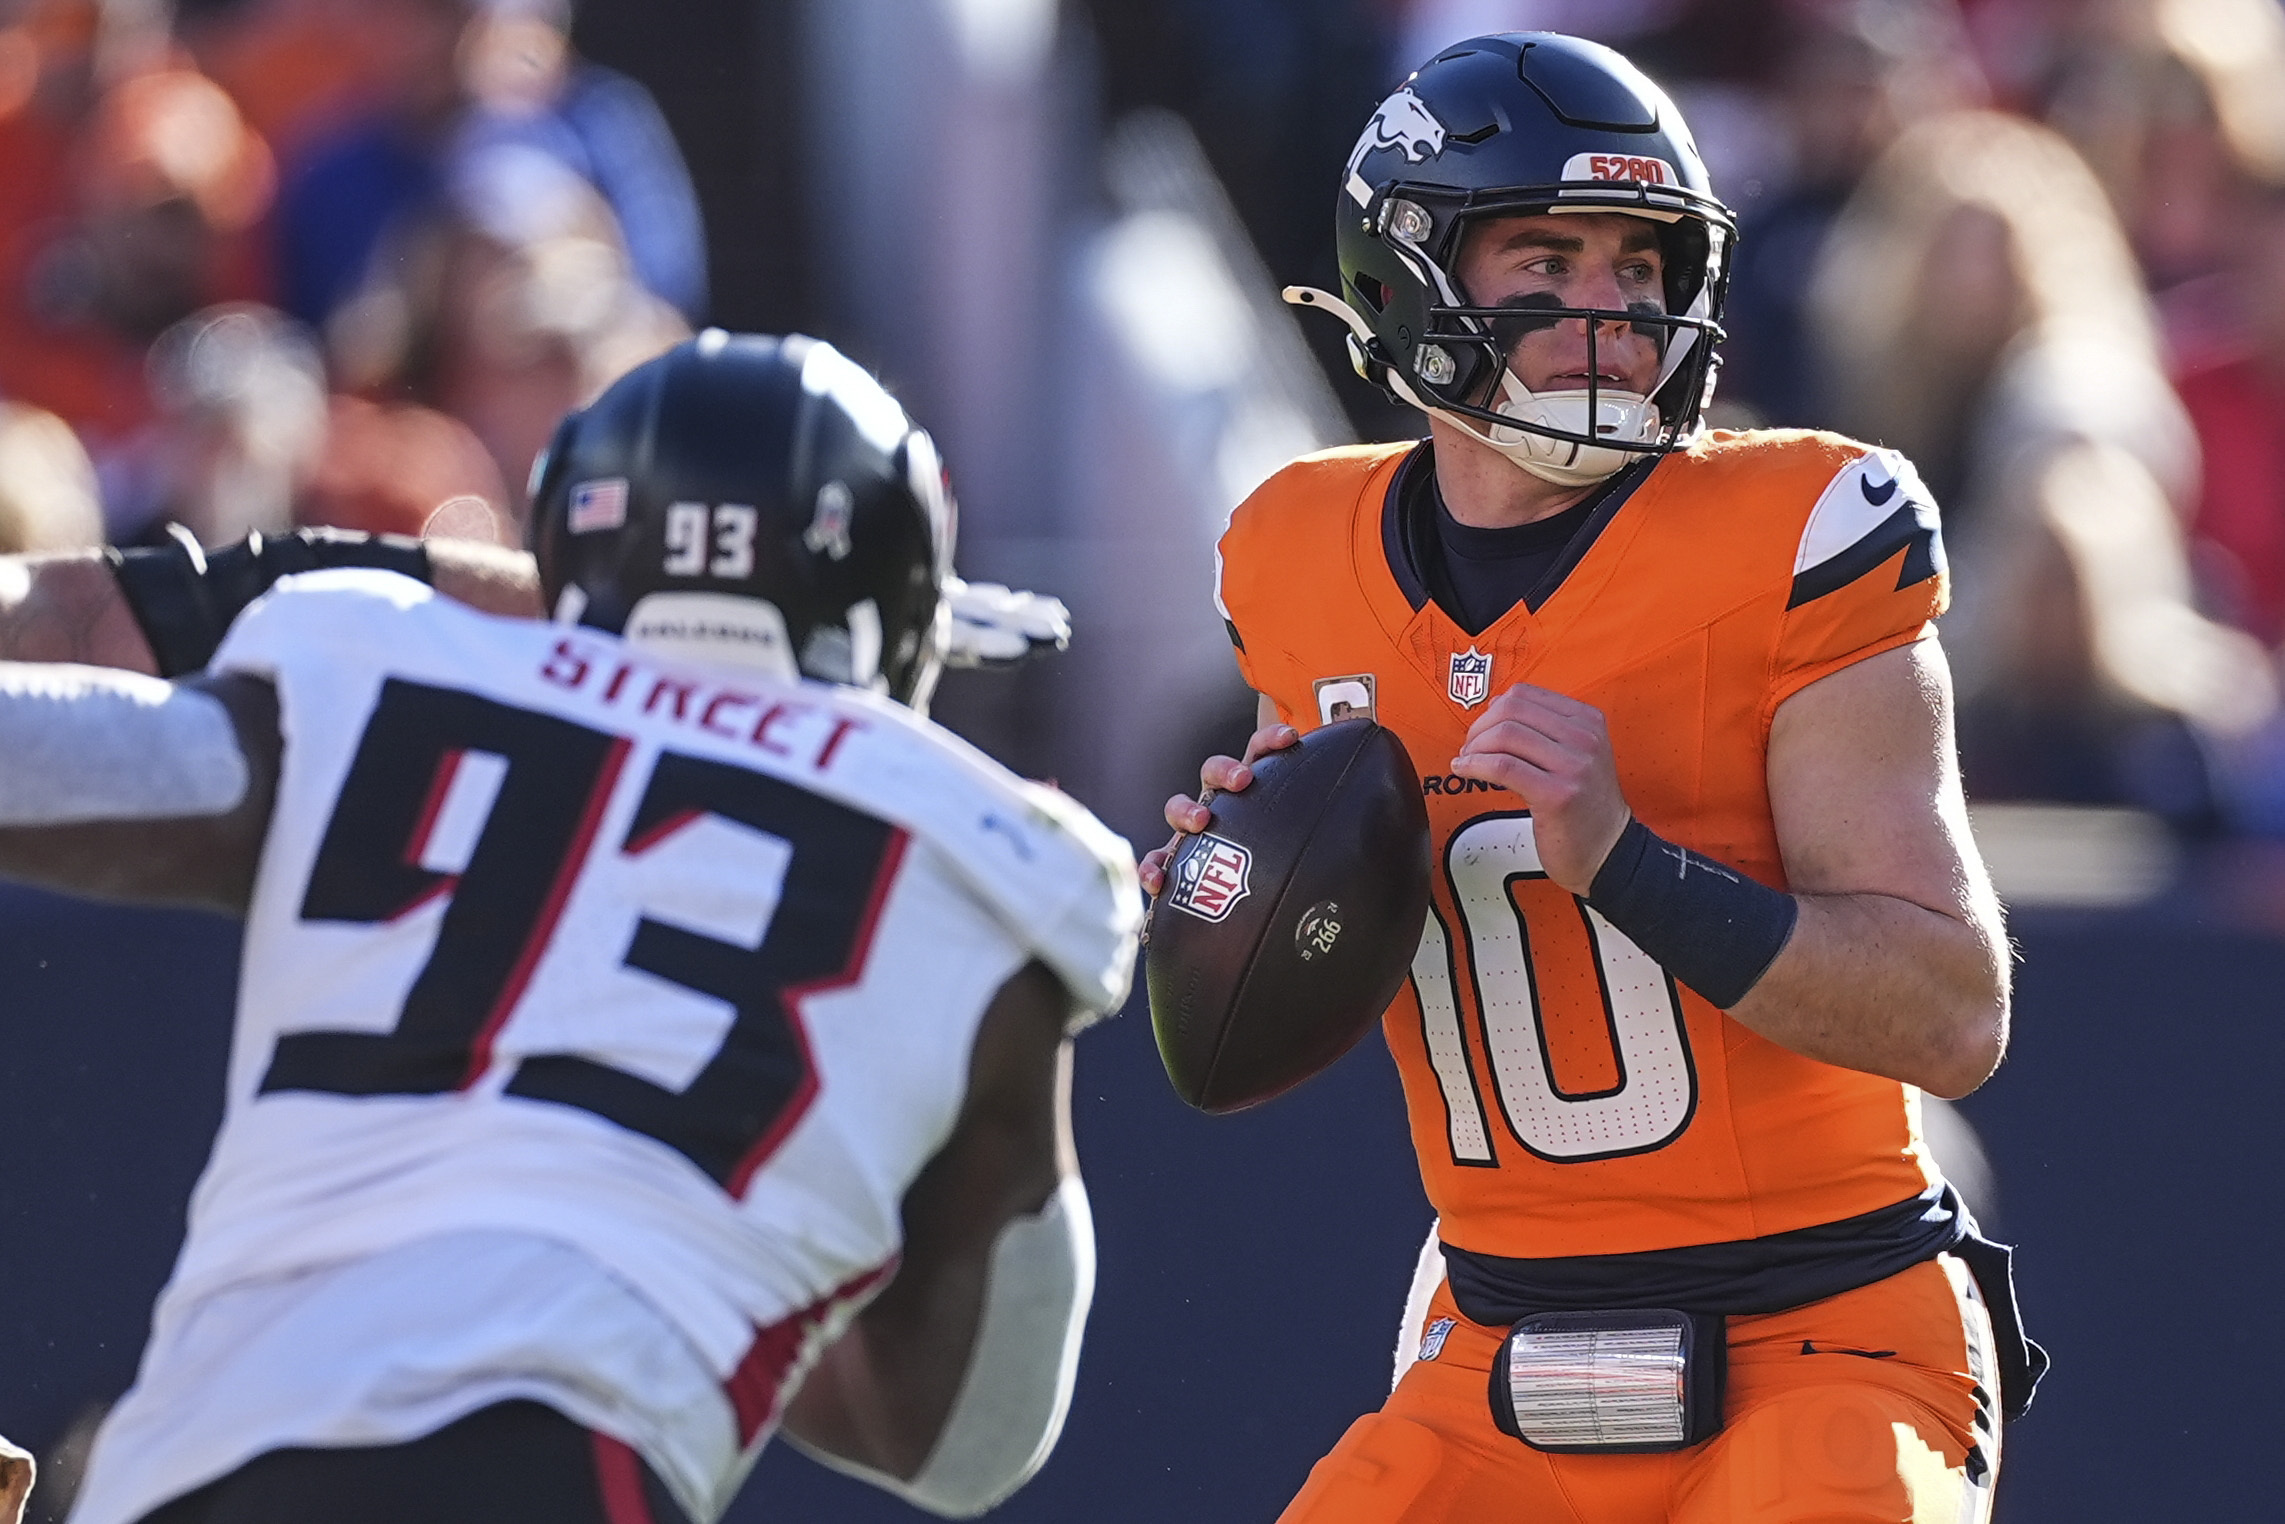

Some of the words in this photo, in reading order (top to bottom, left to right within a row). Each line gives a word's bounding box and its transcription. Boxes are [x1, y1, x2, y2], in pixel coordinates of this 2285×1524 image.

[1590, 156, 1664, 185] 5280
[662, 501, 759, 579] 93
[541, 639, 876, 770] STREET
[1454, 674, 1482, 698] NFL
[1191, 853, 1243, 913] NFL
[257, 675, 910, 1201] 93
[1311, 918, 1341, 954] 266
[1407, 809, 1699, 1168] 10
